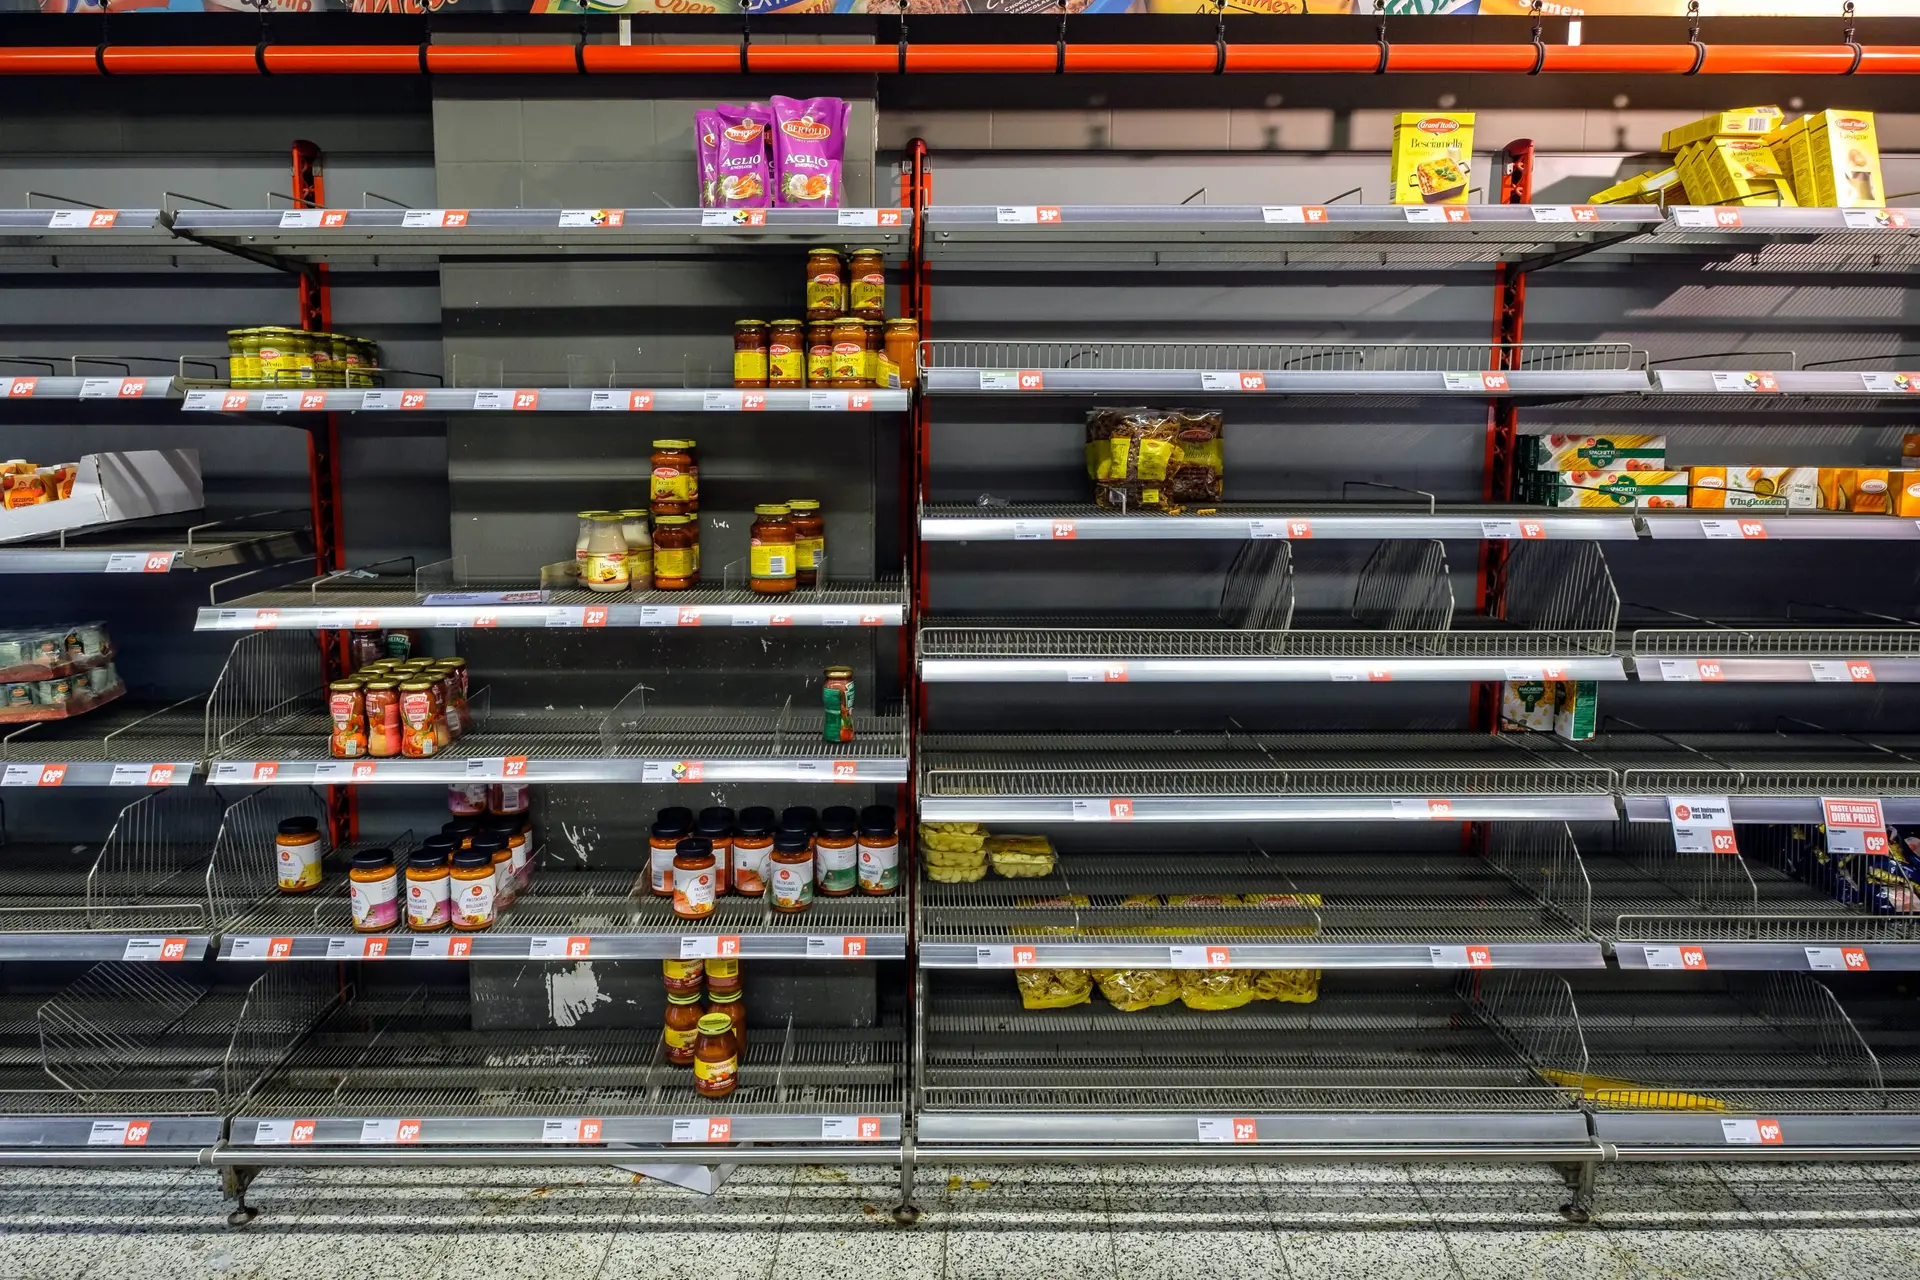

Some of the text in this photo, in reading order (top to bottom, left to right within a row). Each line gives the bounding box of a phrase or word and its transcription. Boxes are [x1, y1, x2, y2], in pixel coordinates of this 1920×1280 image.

[720, 153, 761, 168] AGLIO
[784, 153, 829, 168] AGLIO
[1830, 804, 1848, 812] VASTE
[1831, 813, 1877, 824] DIRK PRIJS
[1714, 835, 1733, 849] 0.72
[1866, 836, 1884, 850] 0.59
